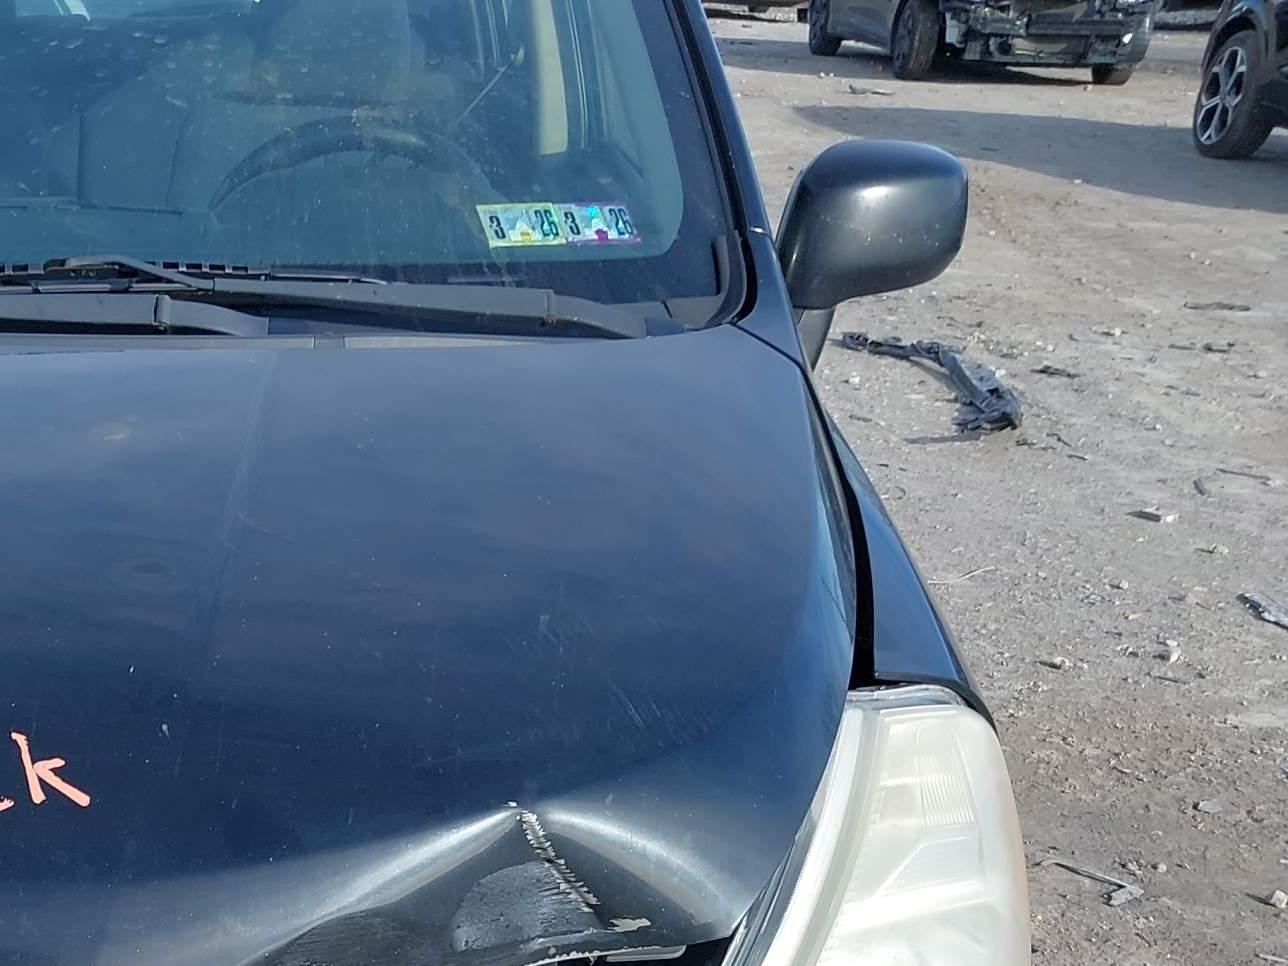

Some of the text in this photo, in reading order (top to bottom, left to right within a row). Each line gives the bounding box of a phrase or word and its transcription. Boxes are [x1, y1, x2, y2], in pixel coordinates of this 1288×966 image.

[489, 209, 559, 240] 3 26
[564, 208, 633, 236] 3 26
